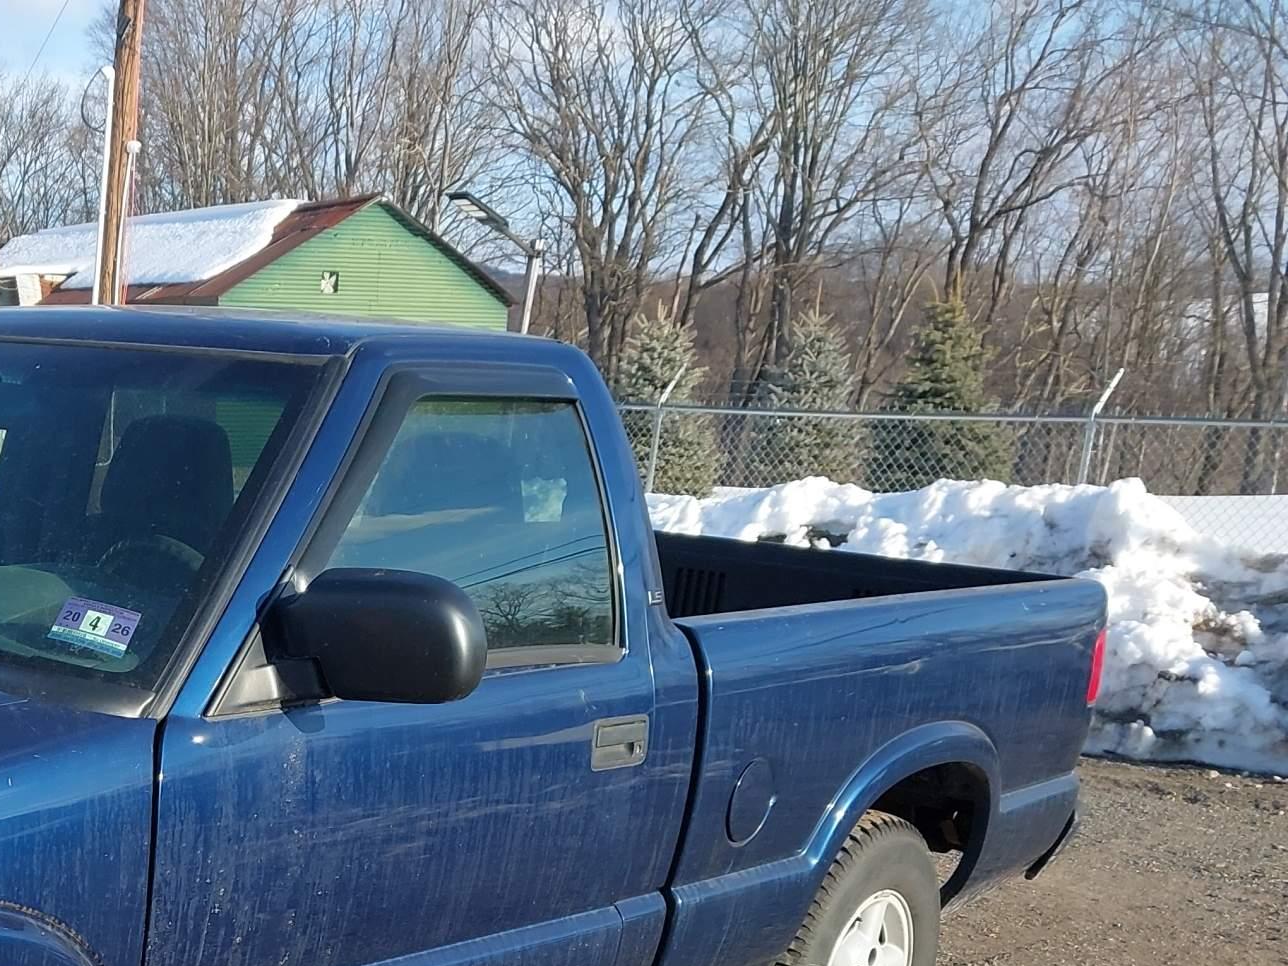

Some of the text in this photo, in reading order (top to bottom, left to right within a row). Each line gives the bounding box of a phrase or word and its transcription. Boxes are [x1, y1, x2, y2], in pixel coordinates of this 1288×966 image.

[647, 590, 663, 606] LS
[63, 610, 131, 637] 20 4 26
